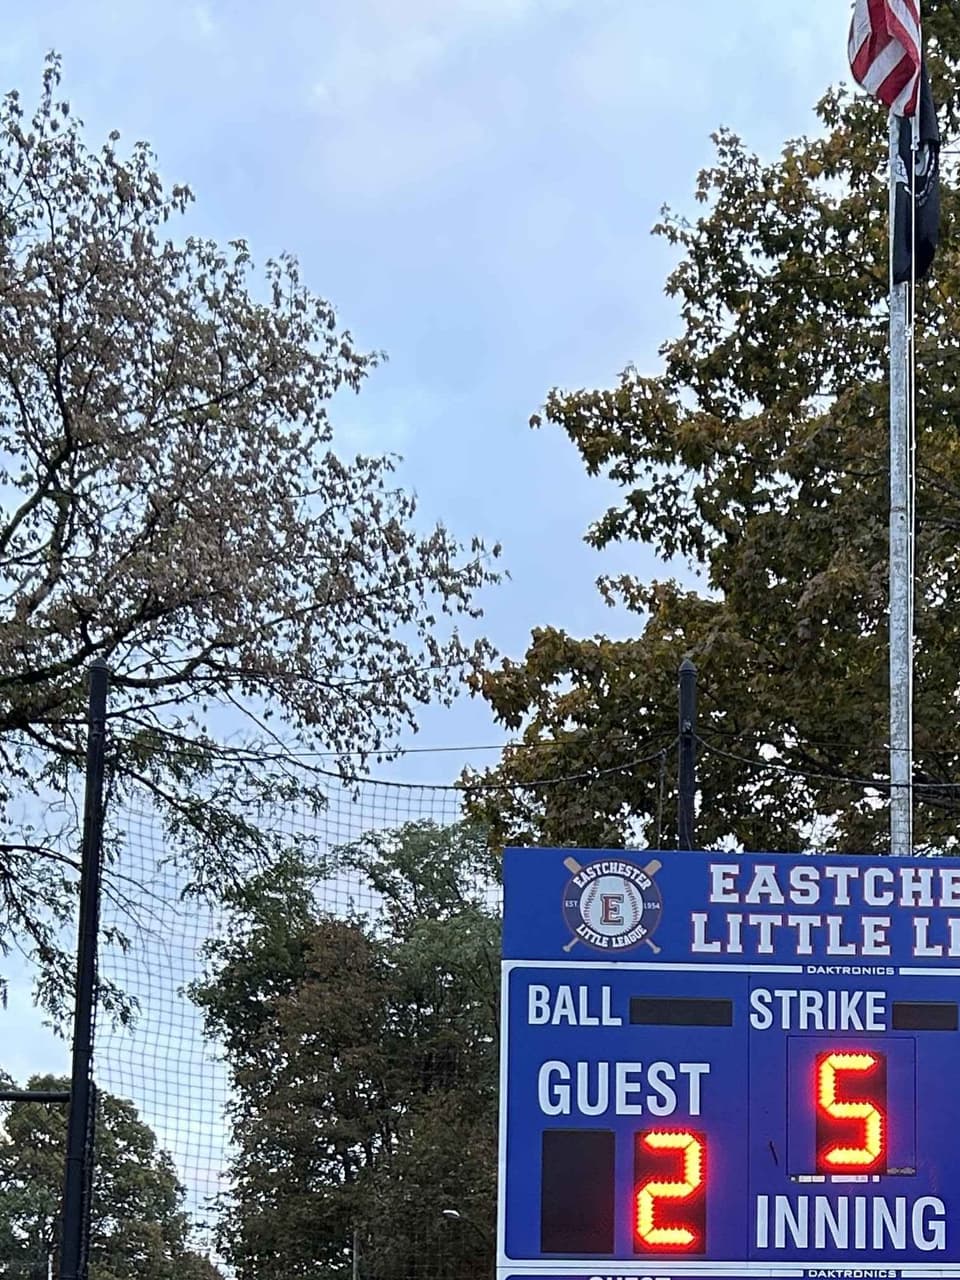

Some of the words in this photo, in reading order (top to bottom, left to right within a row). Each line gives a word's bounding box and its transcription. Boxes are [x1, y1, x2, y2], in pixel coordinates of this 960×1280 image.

[573, 862, 652, 890] EASTCHESTER
[600, 894, 624, 925] E
[576, 923, 609, 947] LITTLE
[612, 924, 648, 948] LEAGUE
[691, 913, 891, 957] LITTLE
[807, 965, 895, 975] DAKTRONICS
[527, 985, 622, 1026] BALL
[749, 989, 887, 1031] STRIKE
[538, 1060, 710, 1116] GUEST
[819, 1053, 882, 1165] 5
[637, 1132, 701, 1245] 2
[756, 1194, 946, 1251] INNING
[808, 1269, 897, 1279] DAKTRONICS
